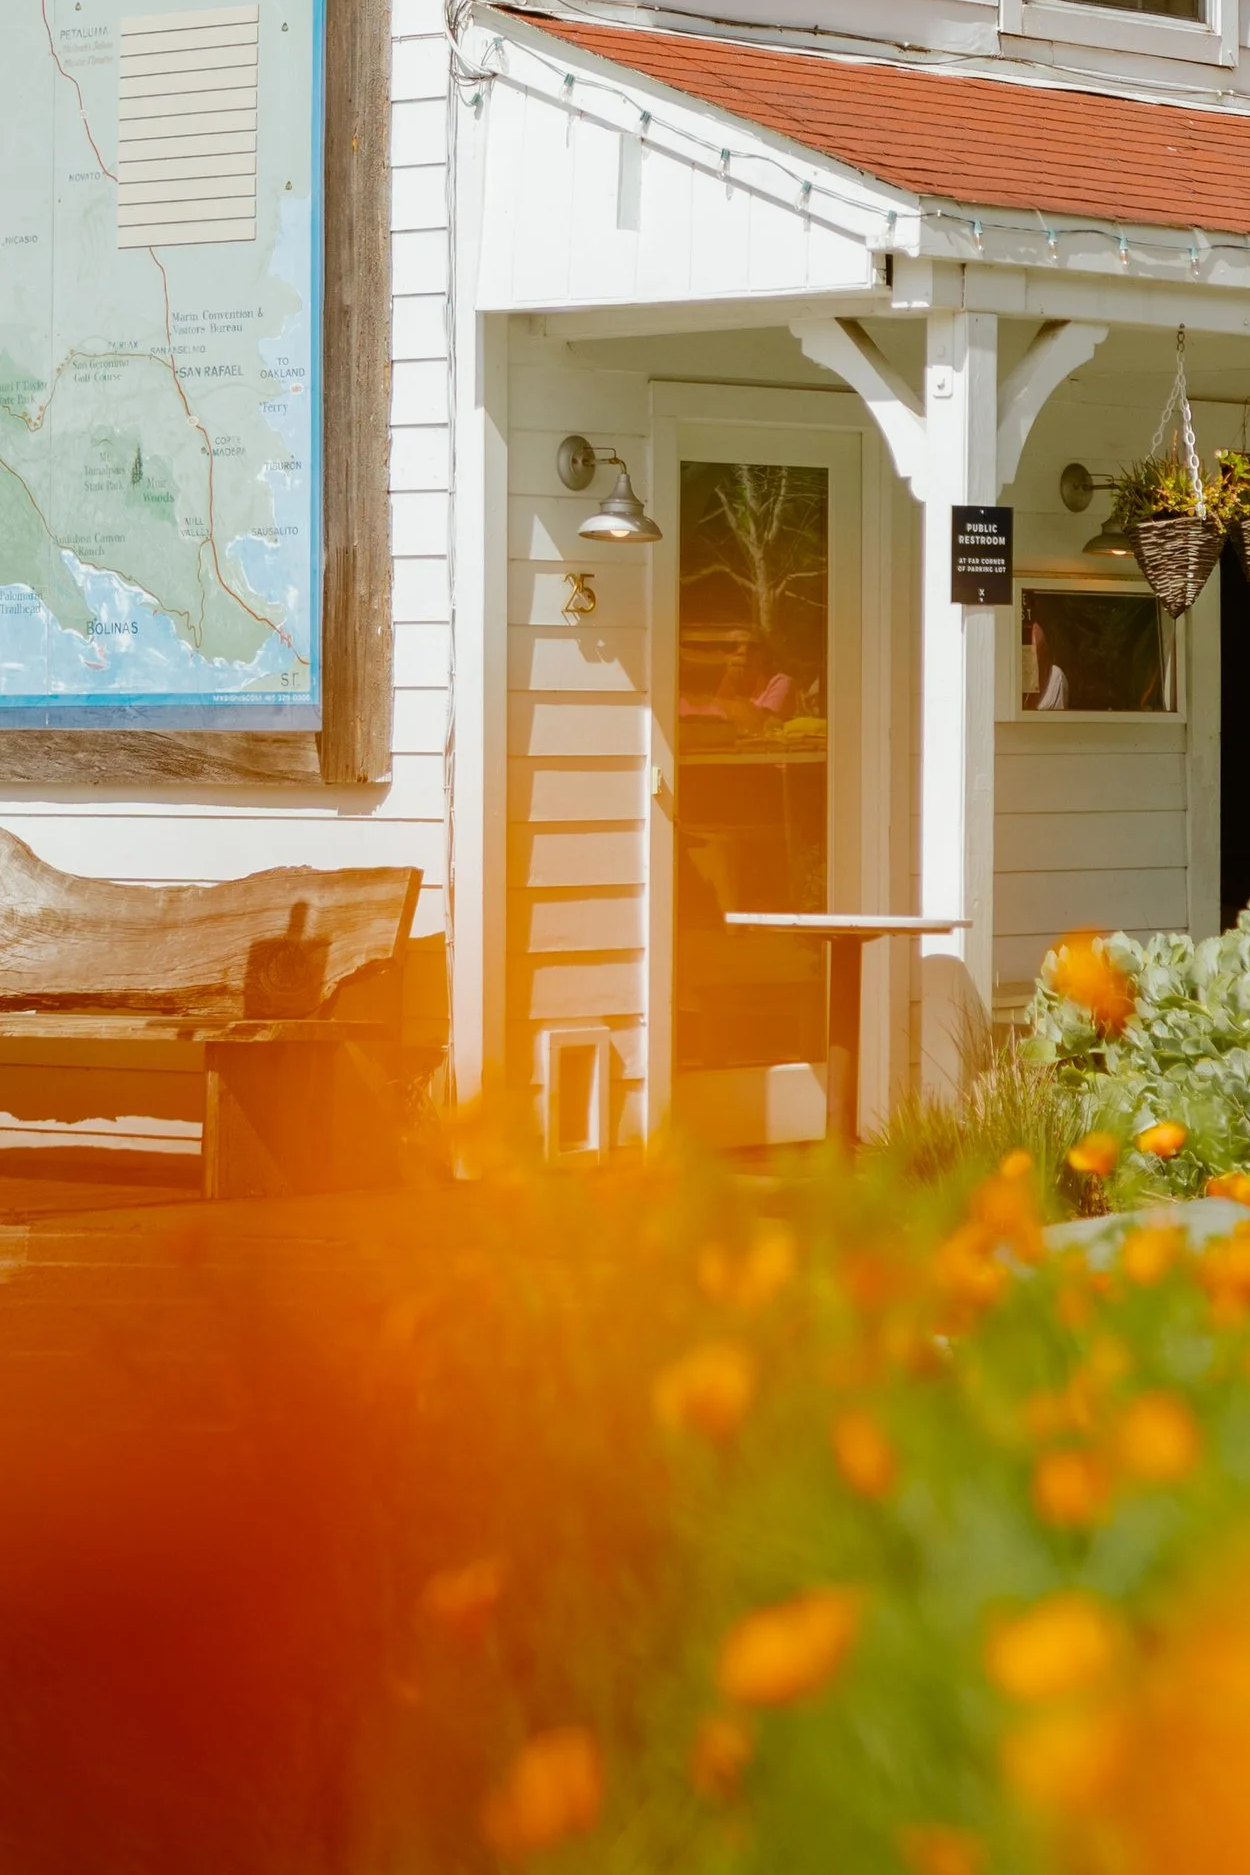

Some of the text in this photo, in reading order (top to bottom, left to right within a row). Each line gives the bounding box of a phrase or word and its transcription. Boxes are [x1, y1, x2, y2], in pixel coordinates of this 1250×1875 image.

[60, 26, 110, 41] PETALUMA
[69, 172, 102, 182] NOVATO
[5, 235, 39, 245] NICASIO
[172, 307, 264, 323] Marin Convention &
[210, 323, 243, 335] Bureau
[277, 357, 289, 366] TO
[179, 365, 244, 379] SAN RAFAEL
[260, 368, 306, 380] OAKLAND
[262, 402, 289, 416] Ferry
[265, 462, 302, 470] TIBURON
[143, 492, 175, 504] Woods
[251, 526, 299, 537] SAUSALITO
[966, 523, 998, 534] PUBLIC
[94, 533, 126, 544] Canyon
[958, 535, 1006, 546] RESTROOM
[981, 558, 1005, 566] CORNER
[995, 566, 1007, 574] LOT
[564, 573, 596, 613] 25
[86, 620, 139, 636] BOLINAS
